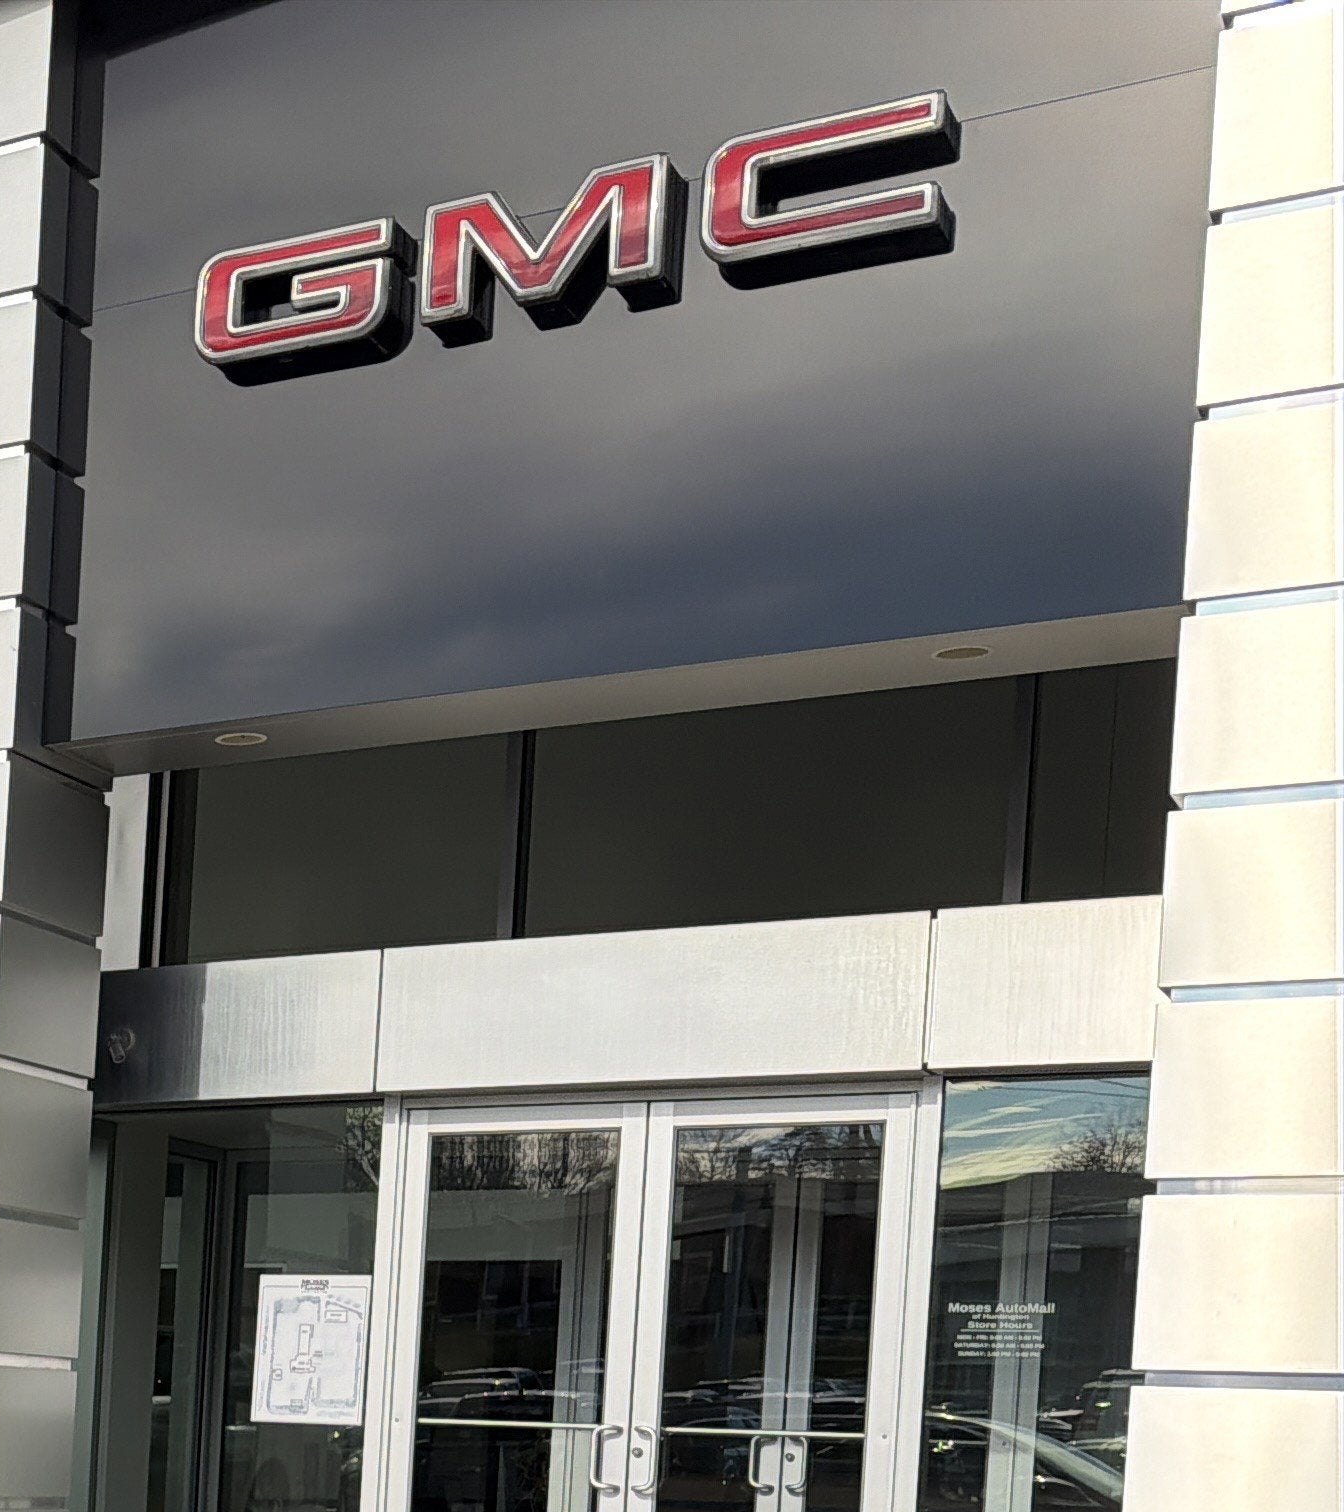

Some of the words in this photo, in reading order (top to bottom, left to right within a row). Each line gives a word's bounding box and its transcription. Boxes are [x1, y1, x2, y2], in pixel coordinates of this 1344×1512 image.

[193, 89, 950, 368] GMC
[948, 1302, 992, 1314] Moses
[995, 1302, 1056, 1314] AutoMall
[967, 1321, 997, 1329] Store
[1000, 1321, 1034, 1330] Hours
